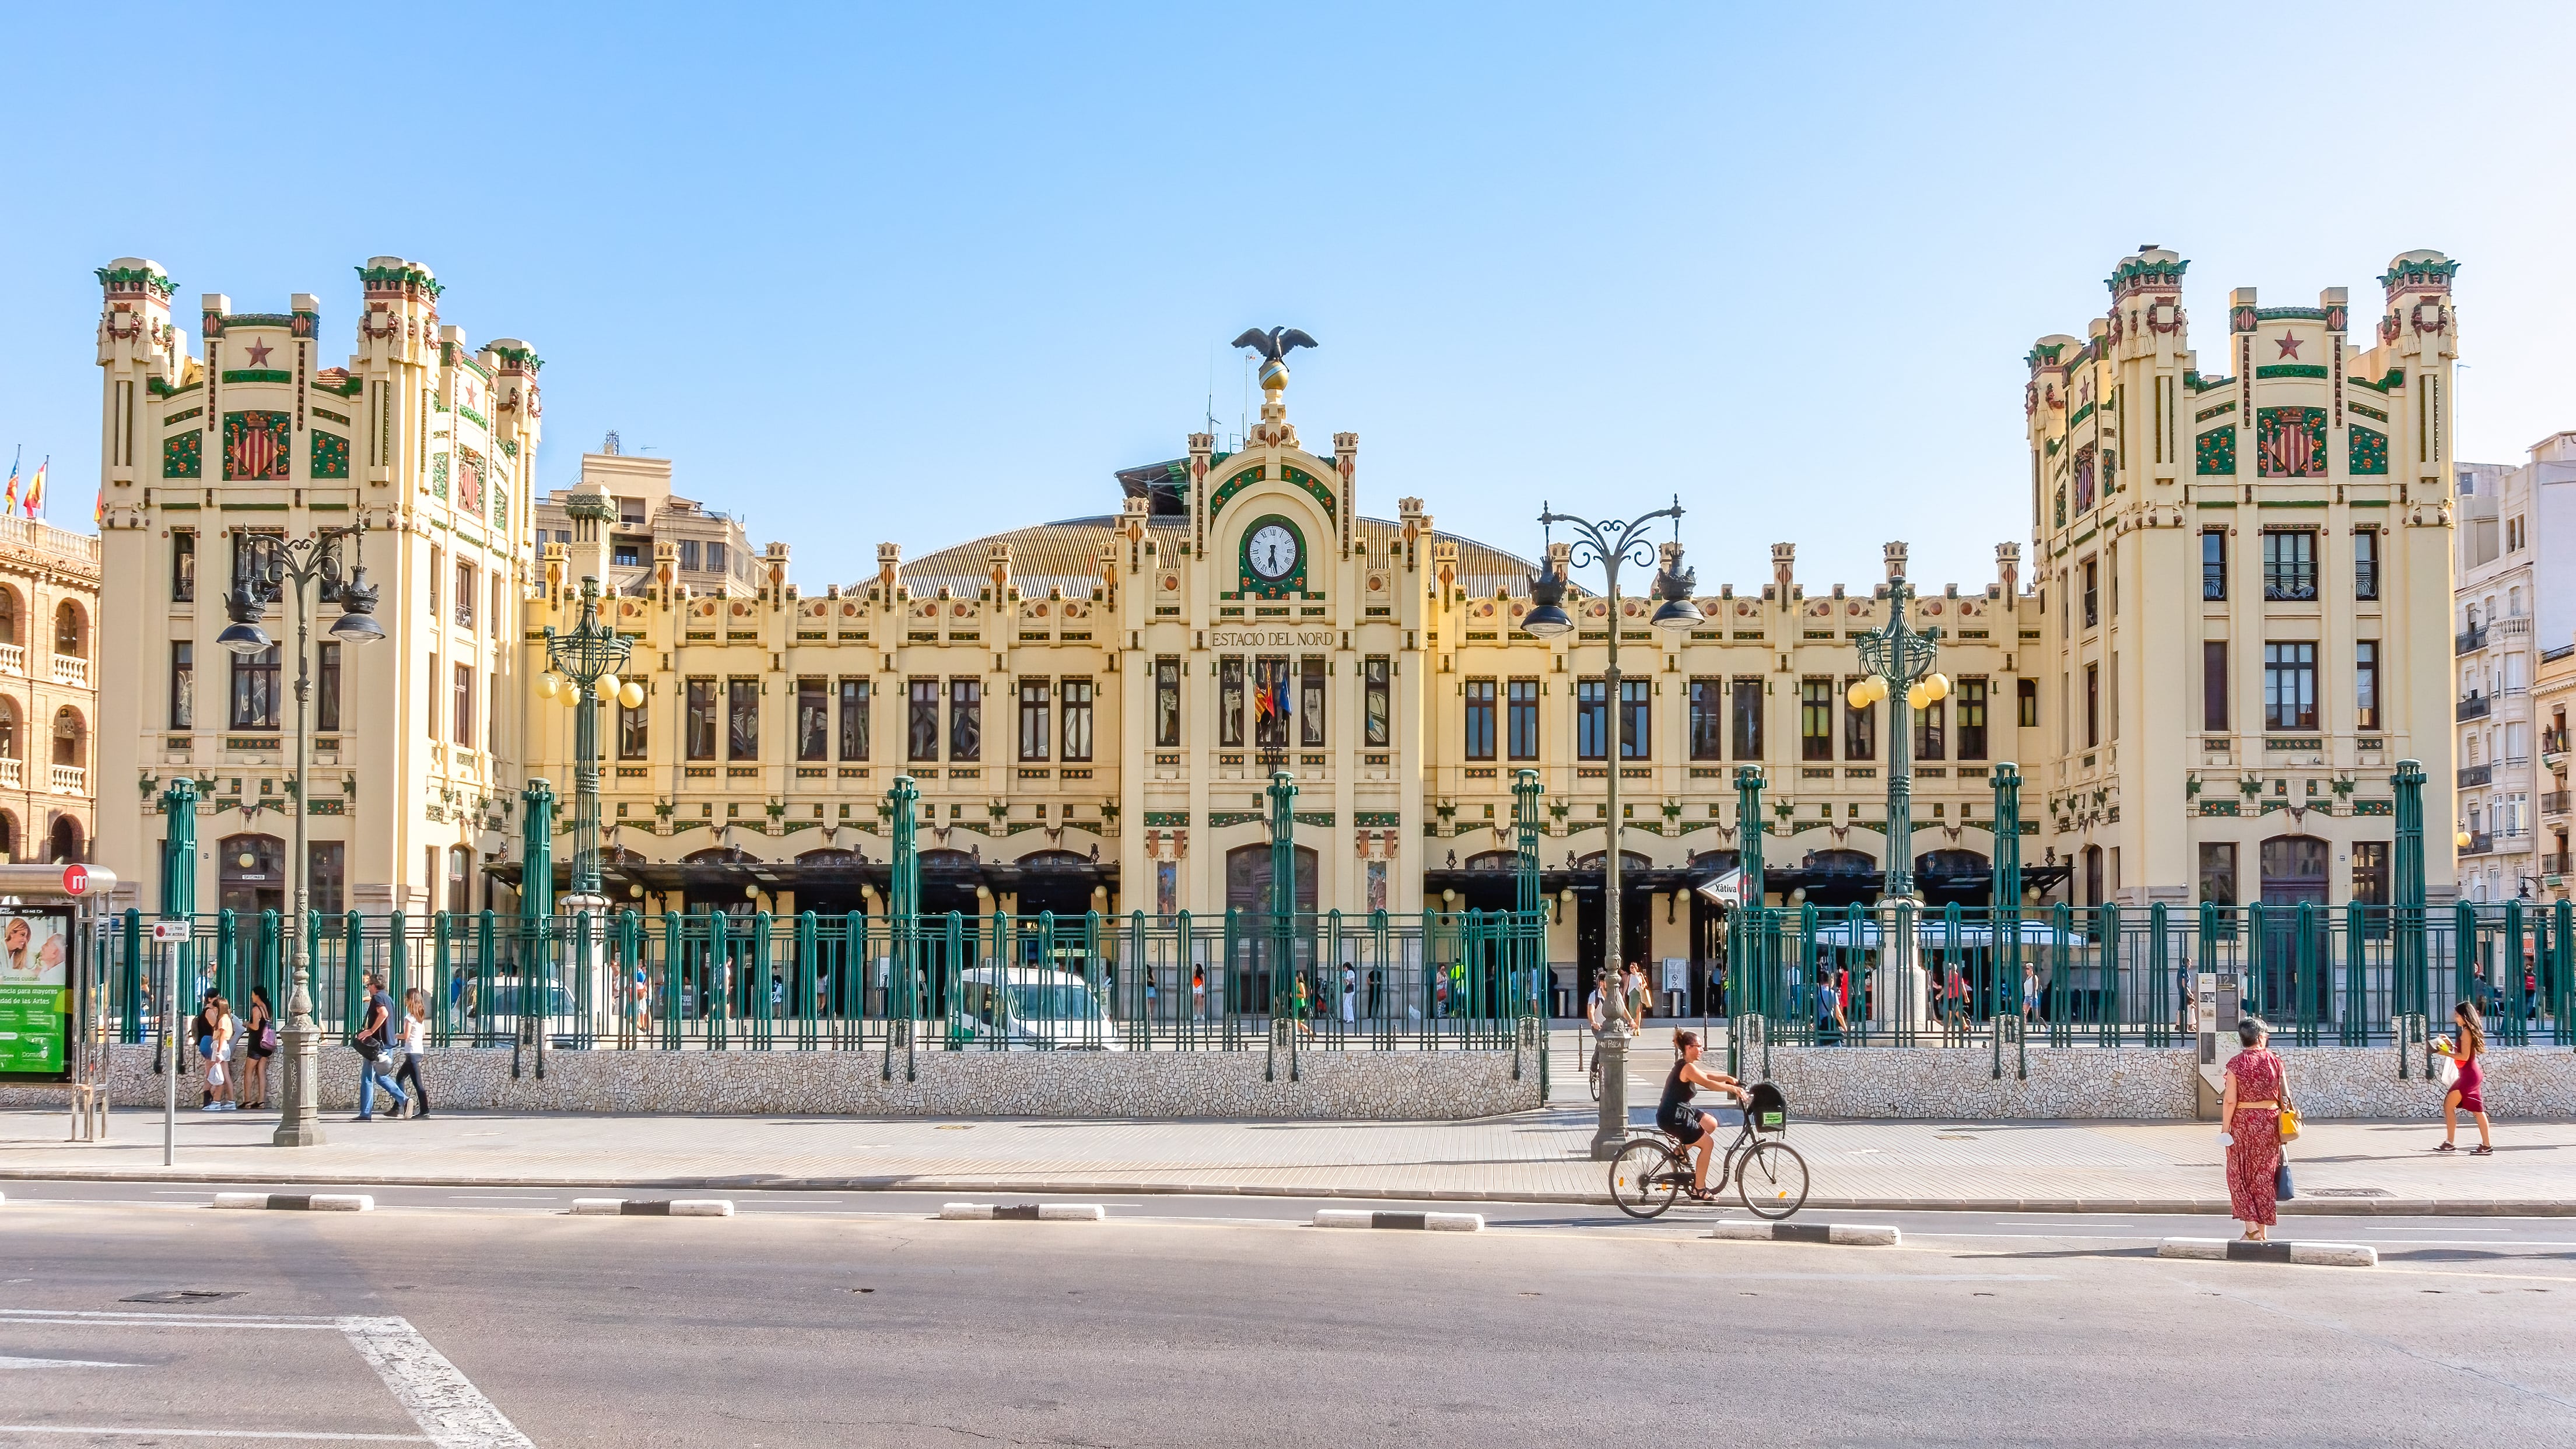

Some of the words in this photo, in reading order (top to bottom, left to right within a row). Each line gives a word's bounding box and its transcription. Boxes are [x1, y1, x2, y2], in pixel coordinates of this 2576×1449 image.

[1212, 629, 1264, 646] ESTACIÓ
[1268, 632, 1295, 645] DEL
[1298, 632, 1334, 645] NORD
[1715, 883, 1737, 893] Xàtiva
